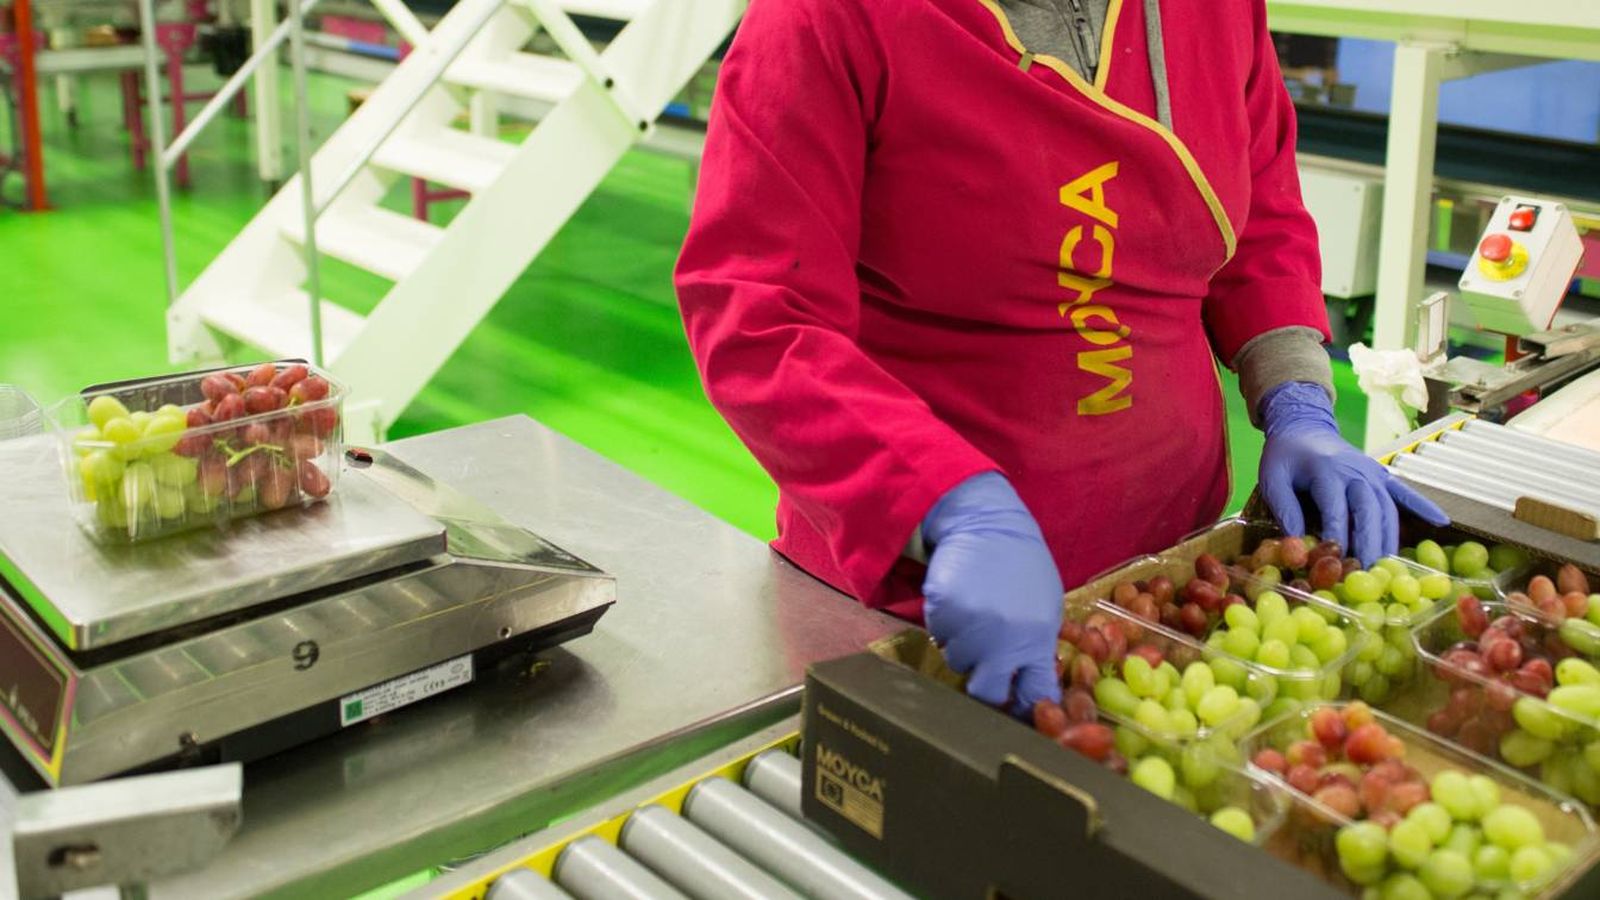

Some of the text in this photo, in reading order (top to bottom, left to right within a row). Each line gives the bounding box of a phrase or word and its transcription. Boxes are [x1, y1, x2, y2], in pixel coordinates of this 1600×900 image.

[1058, 161, 1133, 416] MOYCA
[292, 640, 319, 671] 9
[816, 743, 884, 801] MOYCA
